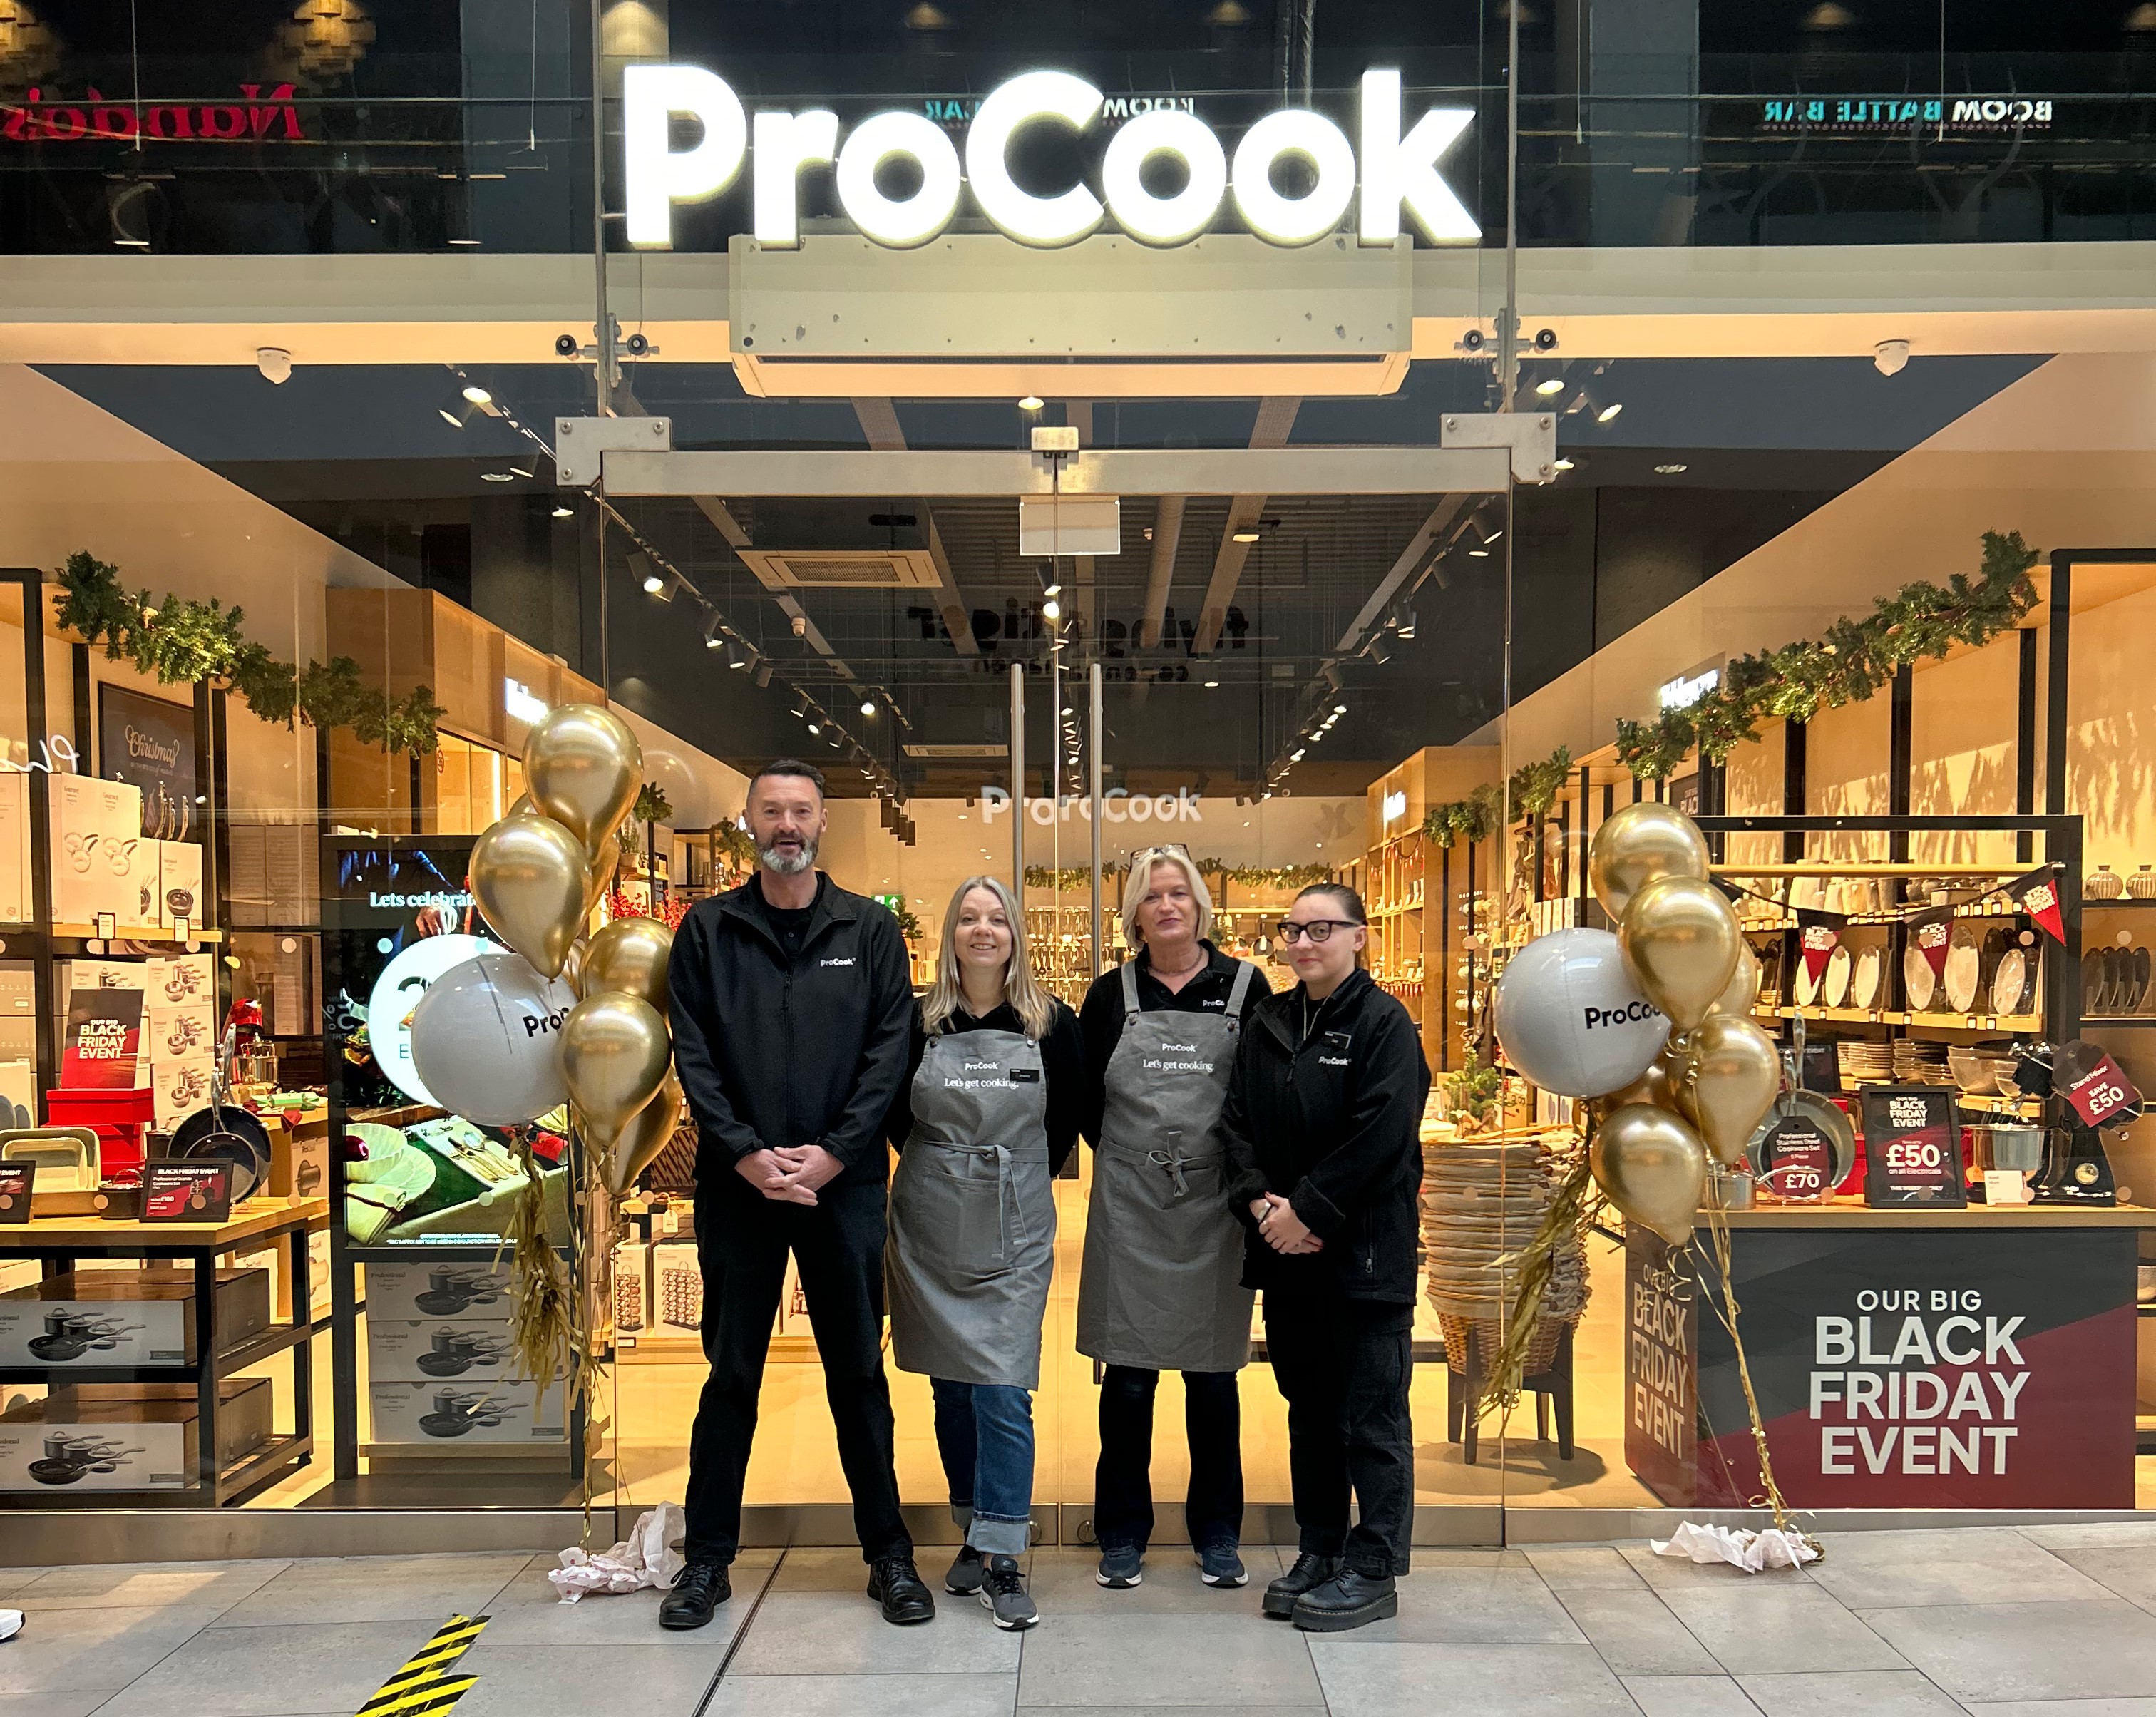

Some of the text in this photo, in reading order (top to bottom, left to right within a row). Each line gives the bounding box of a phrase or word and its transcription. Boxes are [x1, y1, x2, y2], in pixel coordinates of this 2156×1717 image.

[623, 64, 1484, 250] ProCook
[125, 724, 180, 769] Christmas
[369, 891, 476, 907] Lets celebrat
[80, 1025, 127, 1036] BLACK
[78, 1036, 127, 1047] FRIDAY
[1161, 1043, 1196, 1052] ProCook
[79, 1047, 123, 1059] EVENT
[965, 1062, 998, 1070] ProCook
[1143, 1059, 1162, 1069] Let's
[1162, 1061, 1177, 1071] get
[945, 1078, 963, 1087] Let's
[965, 1079, 980, 1090] get
[2070, 1075, 2092, 1090] Stand
[2088, 1082, 2109, 1097] SAVE
[1889, 1100, 1926, 1109] BLACK
[2089, 1086, 2125, 1116] £50
[1889, 1109, 1929, 1119] FRIDAY
[1892, 1118, 1927, 1127] EVENT
[1886, 1144, 1941, 1167] £50
[1785, 1173, 1820, 1189] £70
[1857, 1290, 1983, 1311] OUR BIG
[1633, 1282, 1688, 1355] BLACK
[1815, 1316, 2026, 1365] BLACK
[1631, 1331, 1688, 1408] FRIDAY
[1809, 1371, 2031, 1420] FRIDAY
[1634, 1381, 1685, 1460] EVENT
[1821, 1426, 2018, 1475] EVENT
